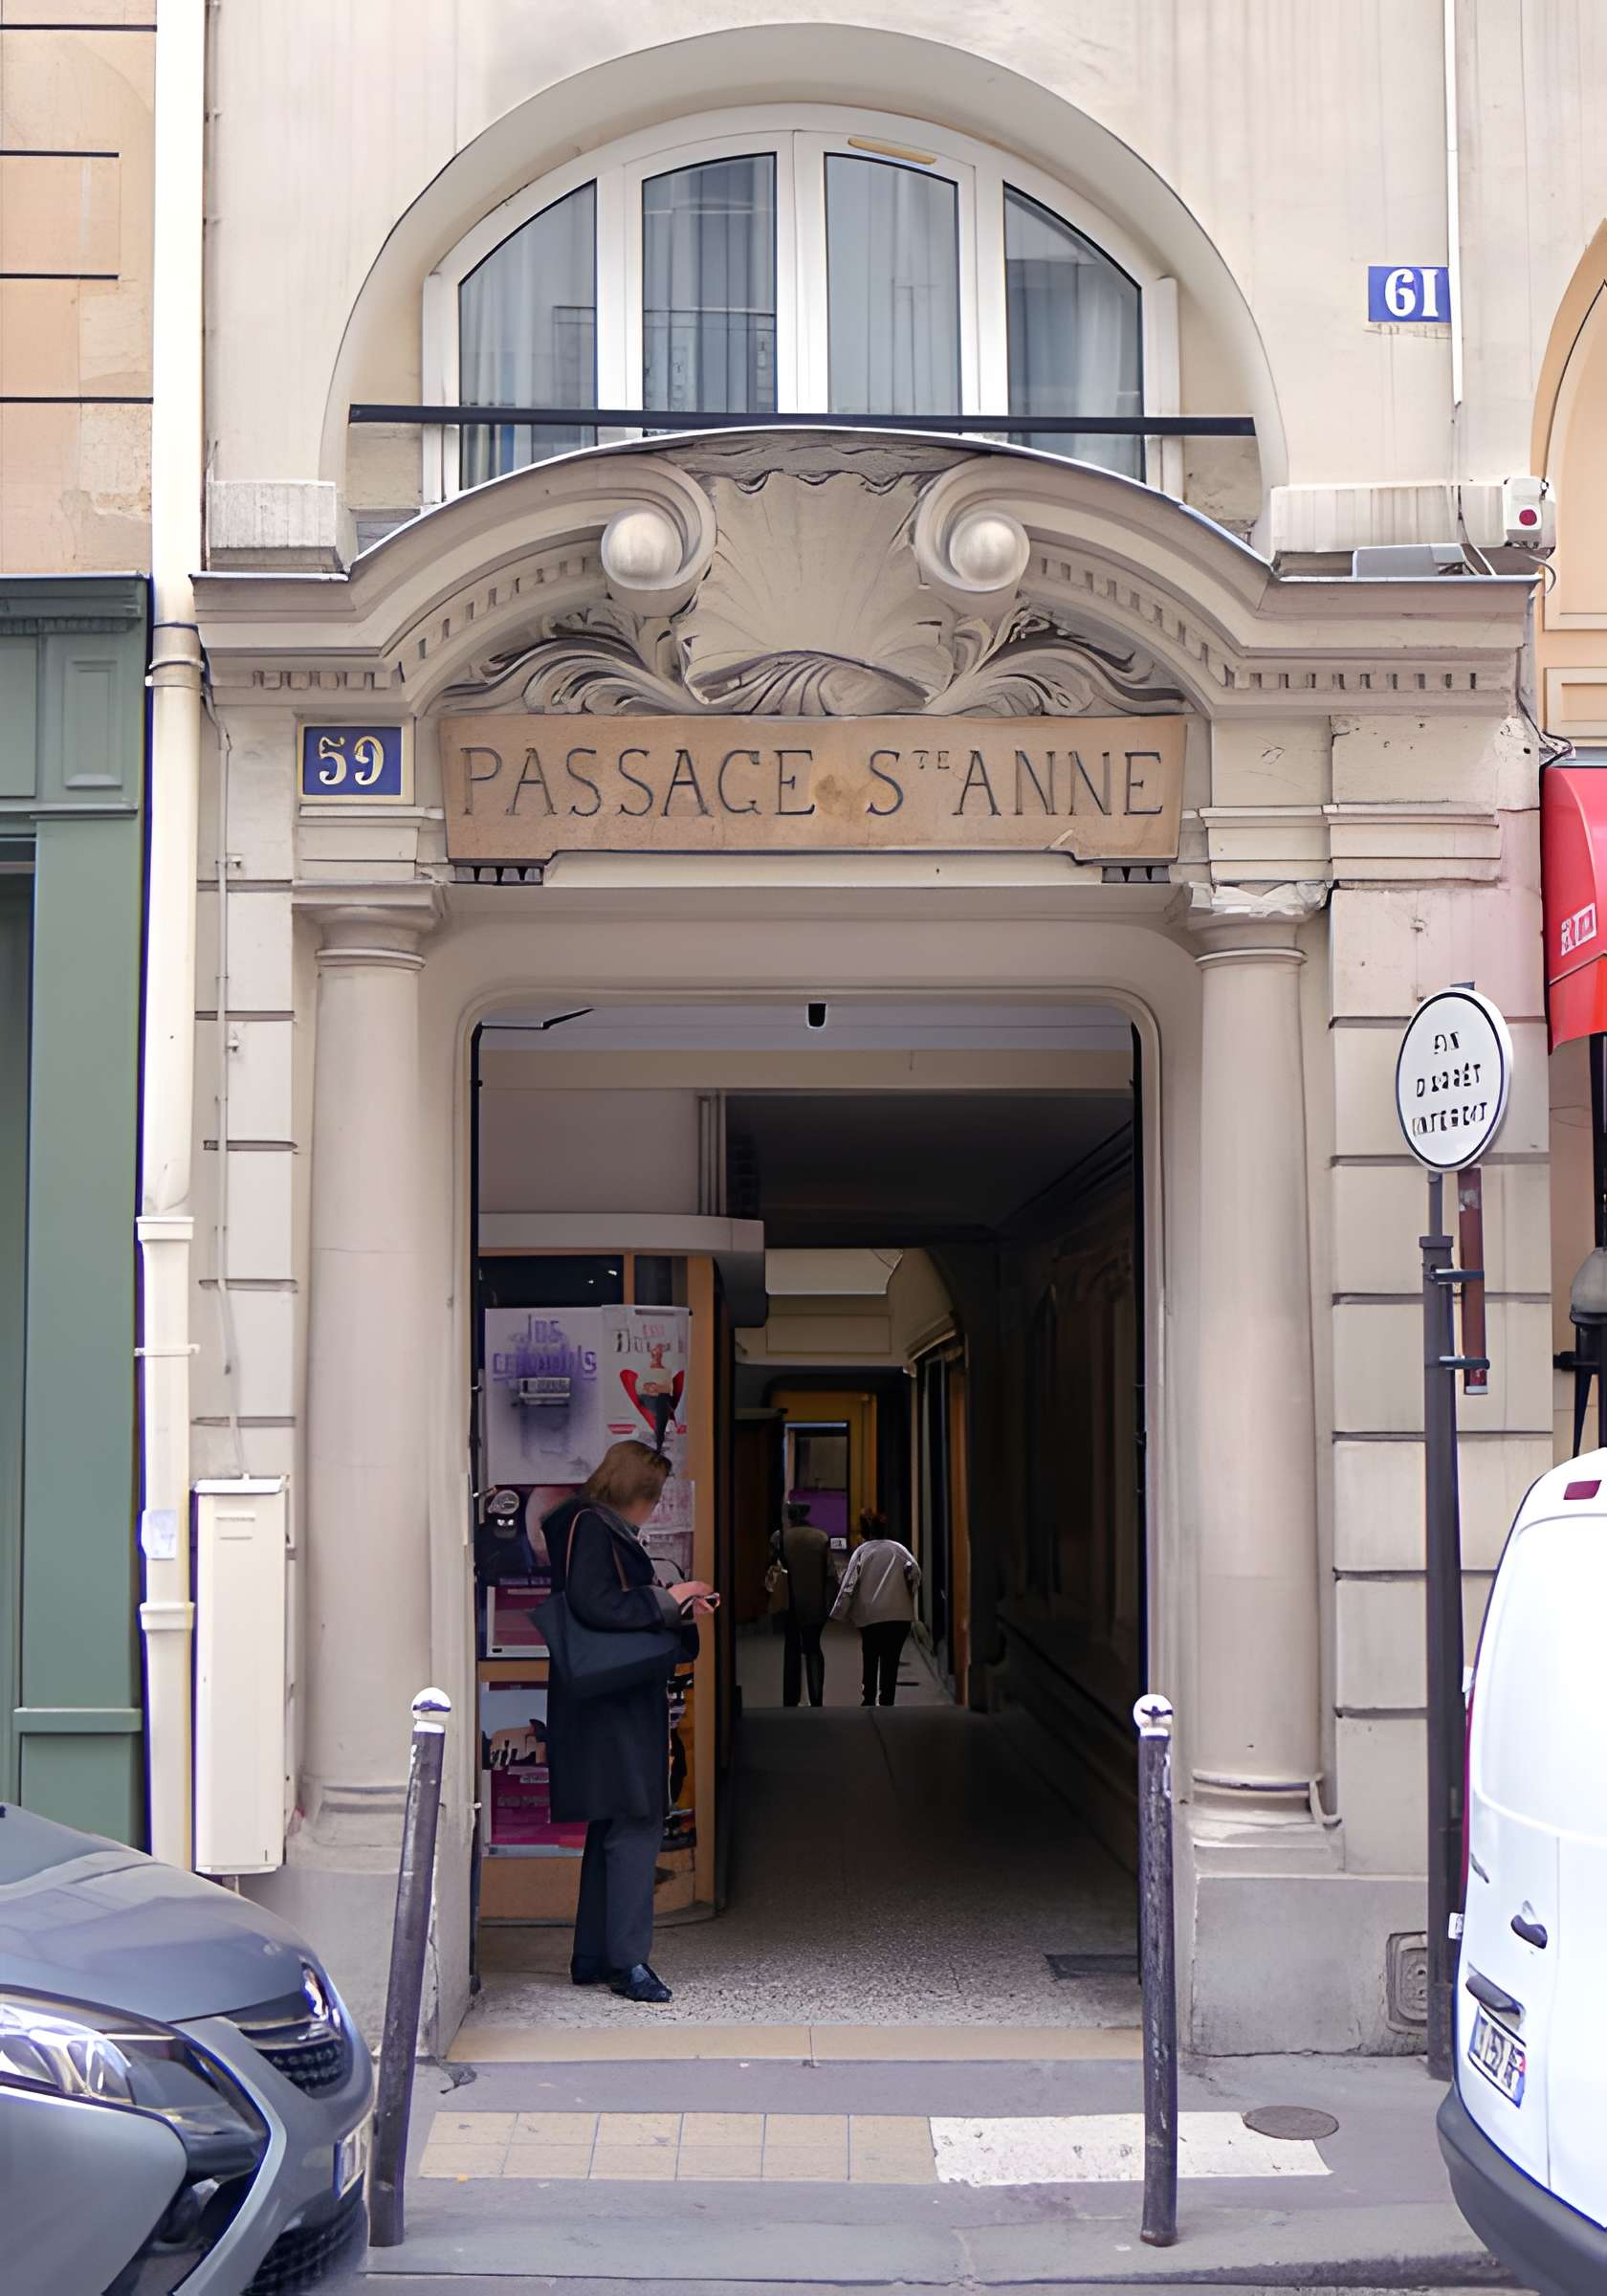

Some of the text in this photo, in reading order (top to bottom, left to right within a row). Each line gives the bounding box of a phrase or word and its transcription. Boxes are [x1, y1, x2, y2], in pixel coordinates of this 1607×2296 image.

[1384, 268, 1439, 318] 61
[319, 736, 385, 785] 59
[460, 747, 816, 817] PASSAGE
[951, 750, 1163, 816] ANNE
